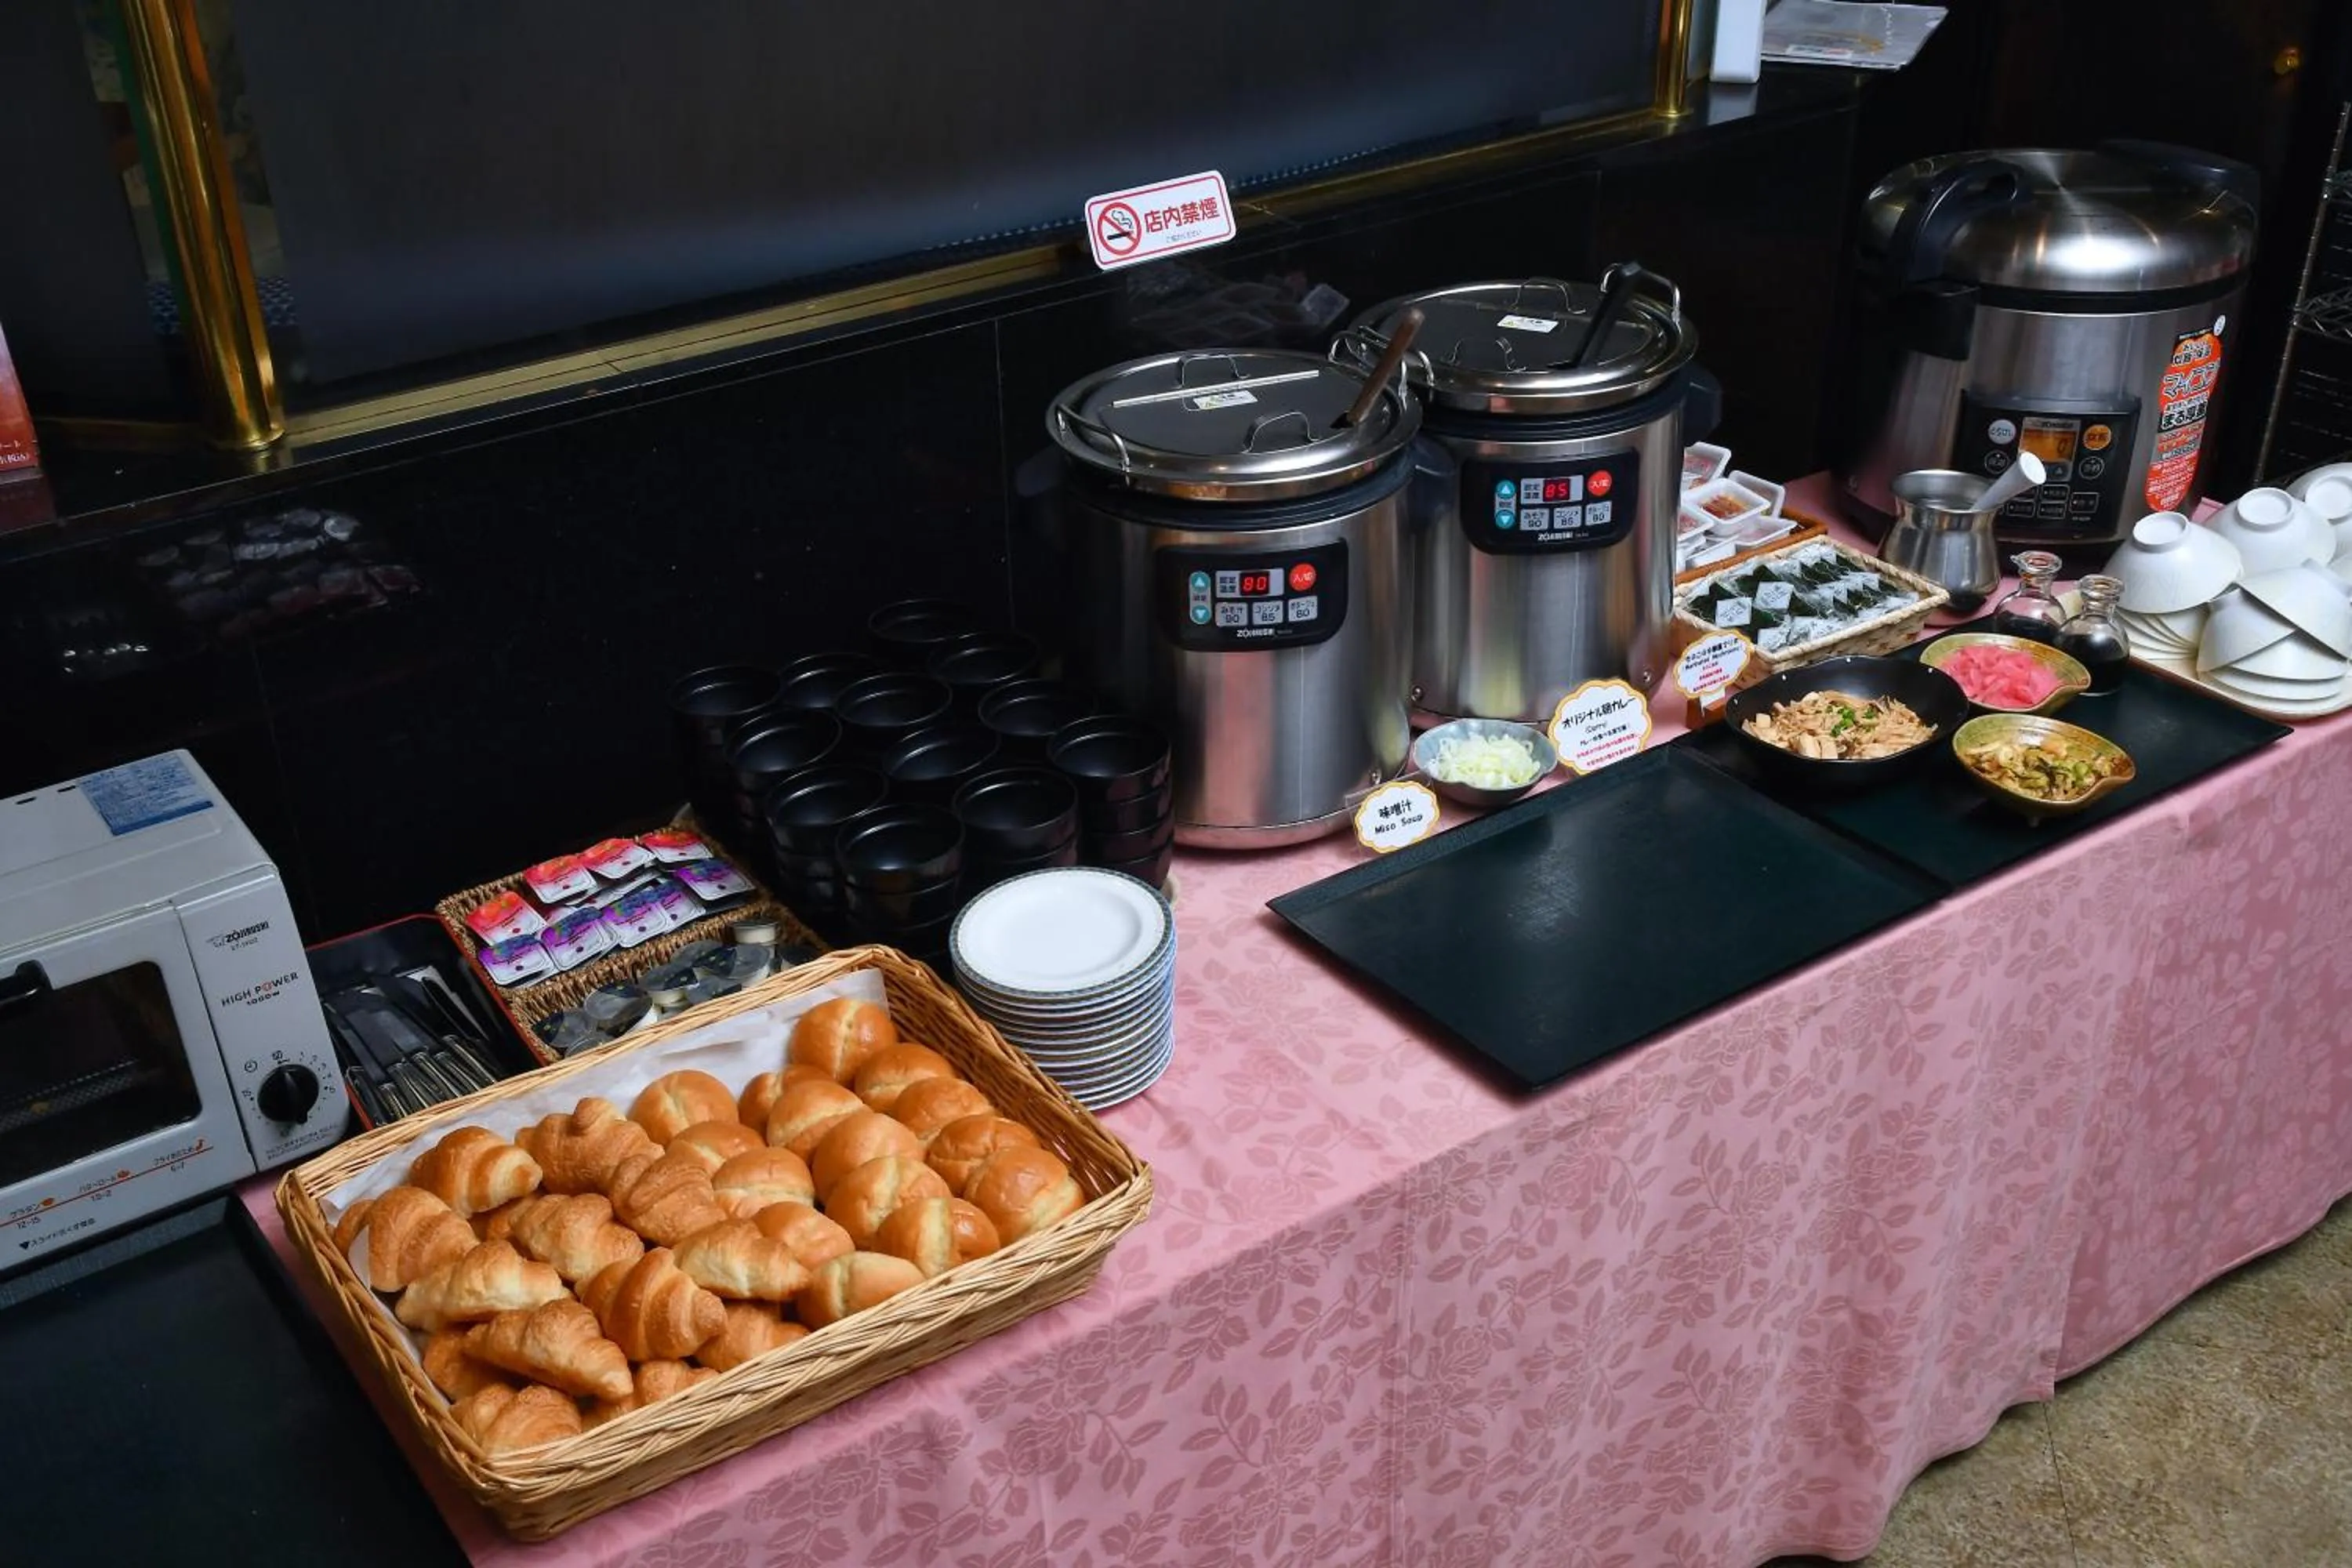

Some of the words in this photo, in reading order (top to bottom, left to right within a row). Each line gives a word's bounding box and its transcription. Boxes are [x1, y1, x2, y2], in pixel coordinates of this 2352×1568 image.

[1144, 197, 1220, 233] 店内禁煙
[1545, 484, 1568, 498] 85
[1296, 608, 1310, 618] 80
[1378, 797, 1412, 819] 味噌汁
[1374, 823, 1396, 834] Miso
[1401, 815, 1423, 827] Soup
[221, 988, 252, 1007] HIGH
[255, 971, 299, 994] POWER
